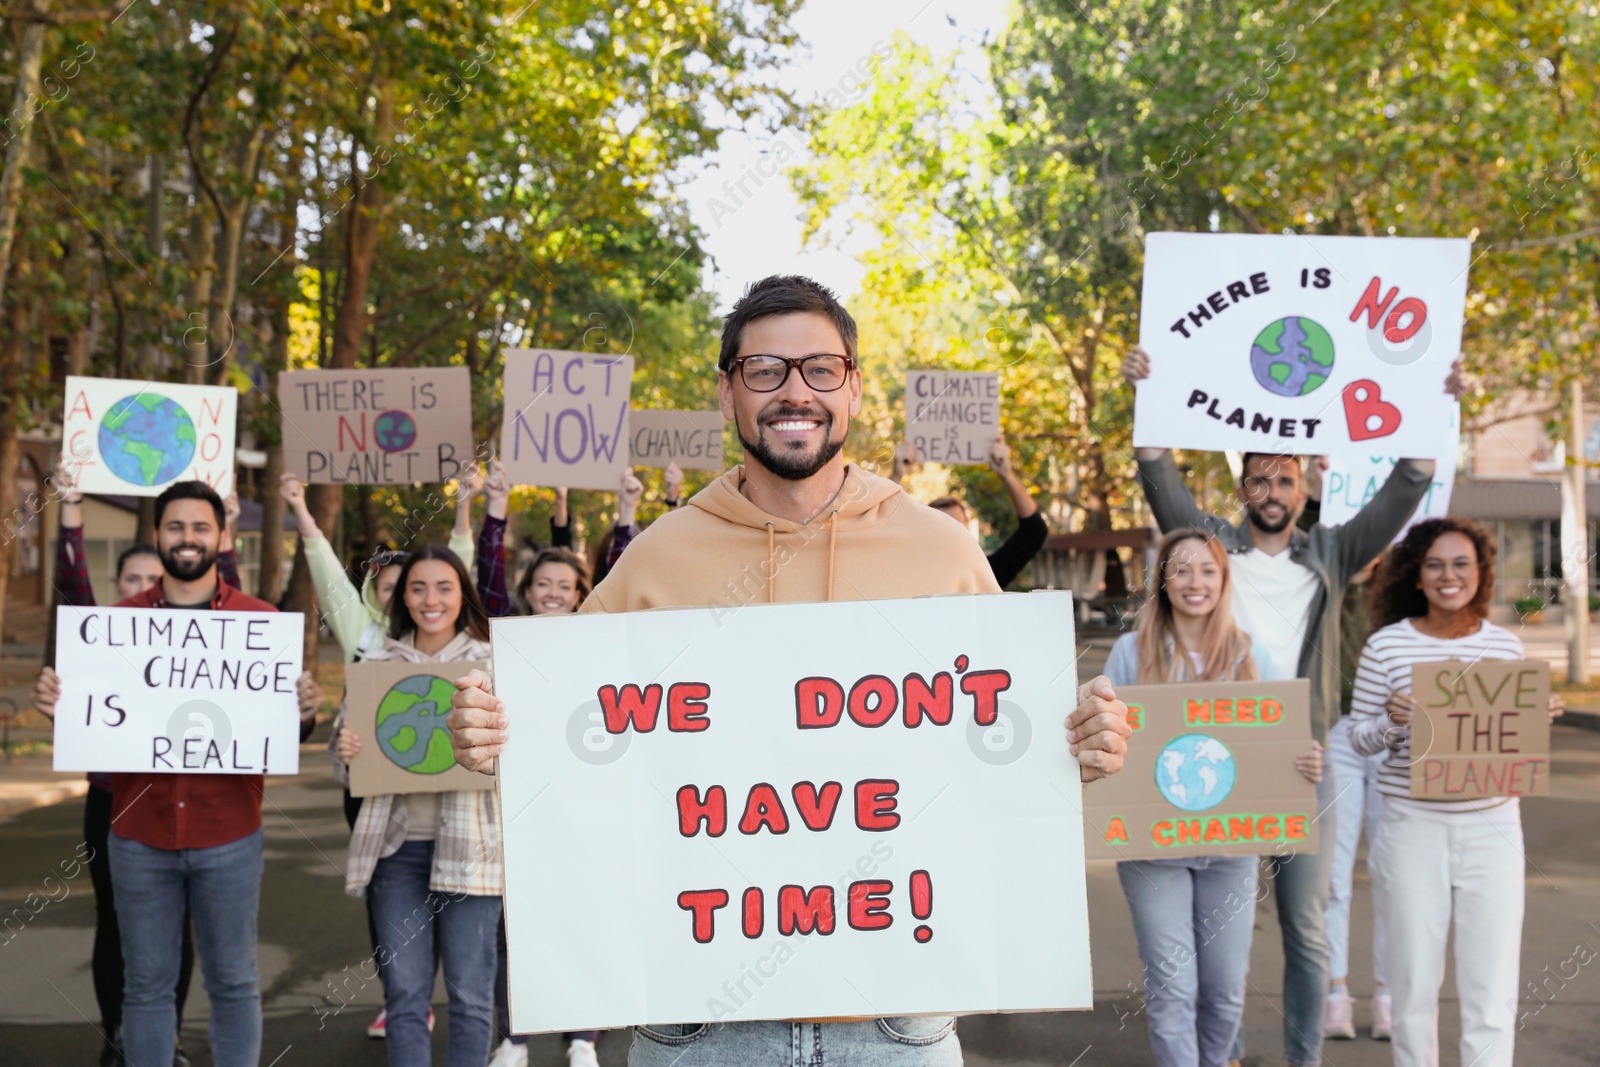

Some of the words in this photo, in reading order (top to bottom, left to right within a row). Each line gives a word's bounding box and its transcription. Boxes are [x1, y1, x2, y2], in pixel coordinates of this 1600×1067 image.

[1170, 272, 1270, 338] THERE
[1300, 268, 1331, 289] IS
[1349, 276, 1427, 343] NO
[532, 352, 623, 397] ACT
[295, 379, 387, 411] THERE
[916, 402, 993, 425] CHANGE
[1187, 389, 1322, 438] PLANET
[1342, 379, 1402, 441] B
[513, 401, 627, 465] NOW
[634, 427, 722, 460] CHANGE
[914, 436, 983, 461] REAL
[307, 451, 420, 482] PLANET
[438, 443, 461, 482] B
[1327, 472, 1444, 515] PLAT
[79, 613, 270, 650] CLIMATE
[144, 655, 294, 693] CHANGE
[1428, 669, 1539, 709] SAVE
[86, 694, 126, 727] IS
[597, 681, 711, 734] WE
[794, 654, 1011, 729] DON'T
[1186, 697, 1284, 725] NEED
[1447, 712, 1520, 753] THE
[152, 736, 269, 774] REAL!
[1424, 758, 1547, 796] PLANET
[676, 778, 902, 838] HAVE
[1105, 817, 1129, 842] A
[1151, 814, 1308, 846] CHANGE
[677, 869, 933, 944] TIME!
